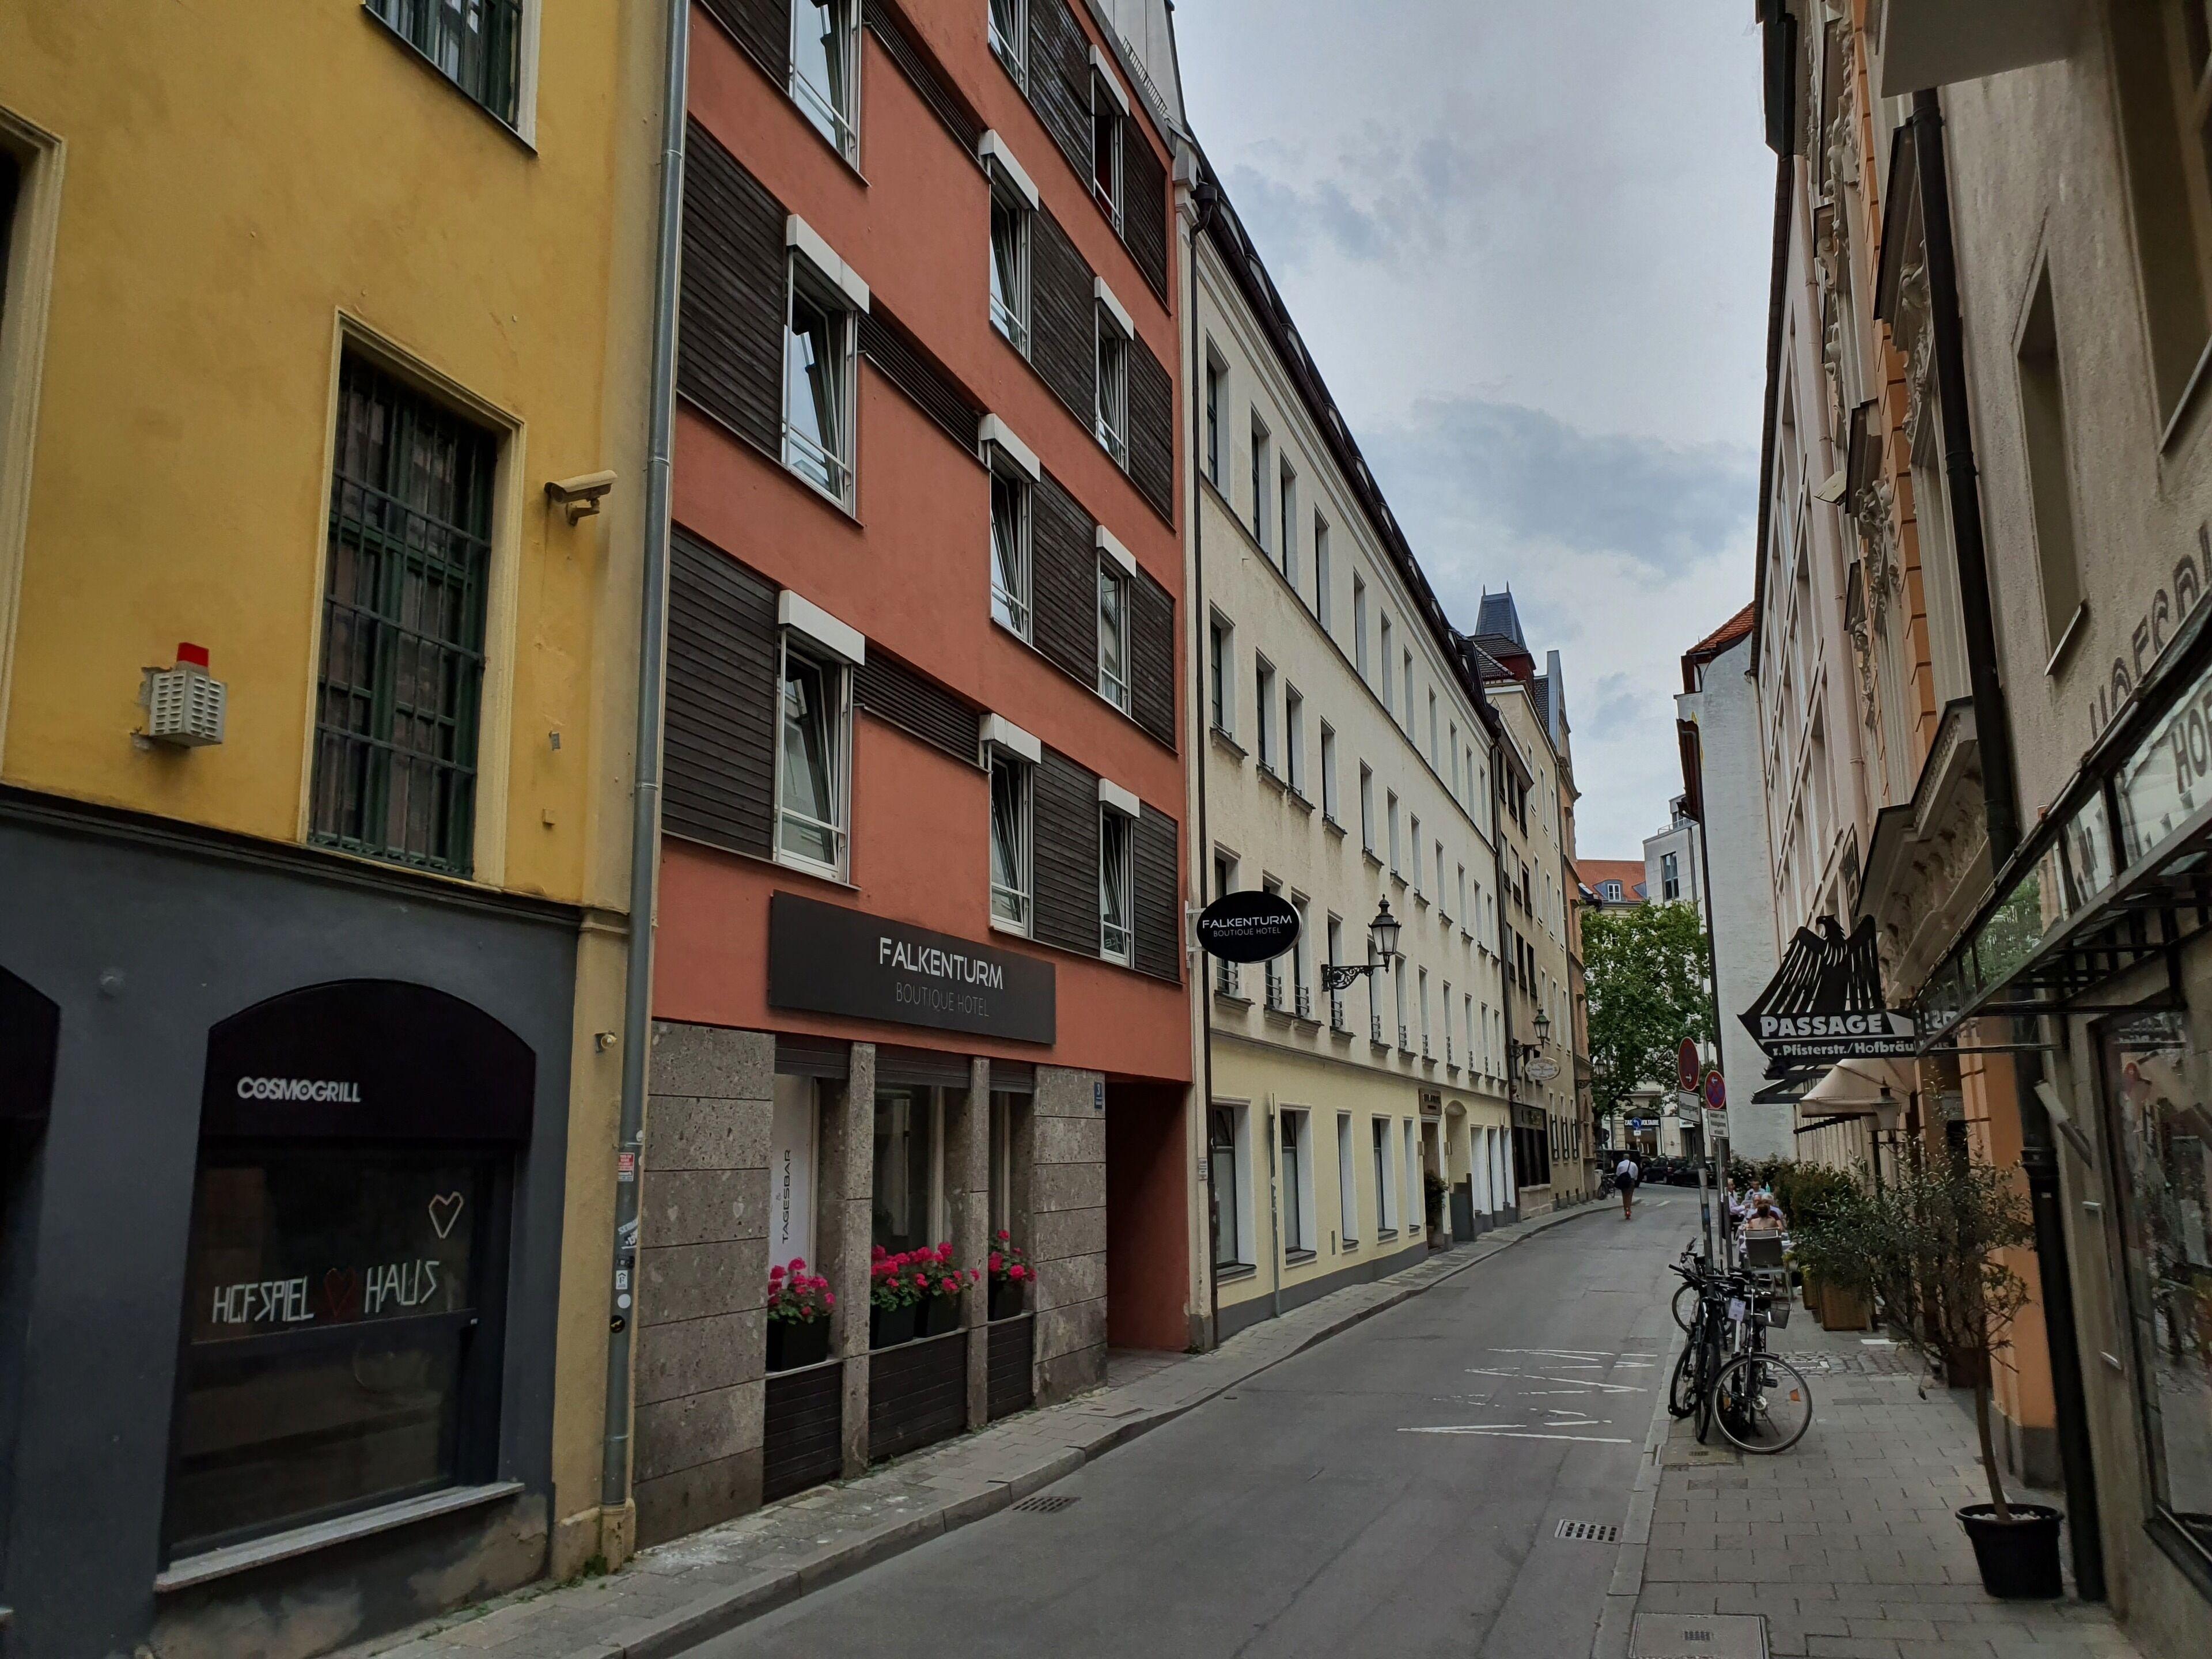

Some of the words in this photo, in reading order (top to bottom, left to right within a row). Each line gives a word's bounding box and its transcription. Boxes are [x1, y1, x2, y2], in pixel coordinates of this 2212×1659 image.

[1202, 915, 1292, 929] FALKENTURM
[1213, 928, 1253, 937] BOUTIQUE
[1256, 927, 1281, 935] HOTEL
[879, 936, 1003, 990] FALKENTURM
[896, 982, 955, 1012] BOUTIQUE
[958, 994, 990, 1017] HOTEL
[1760, 1014, 1883, 1037] PASSAGE
[237, 1077, 361, 1103] COSMOGRILL
[782, 1149, 791, 1244] TAGESBAR
[365, 1259, 440, 1313] HAUS
